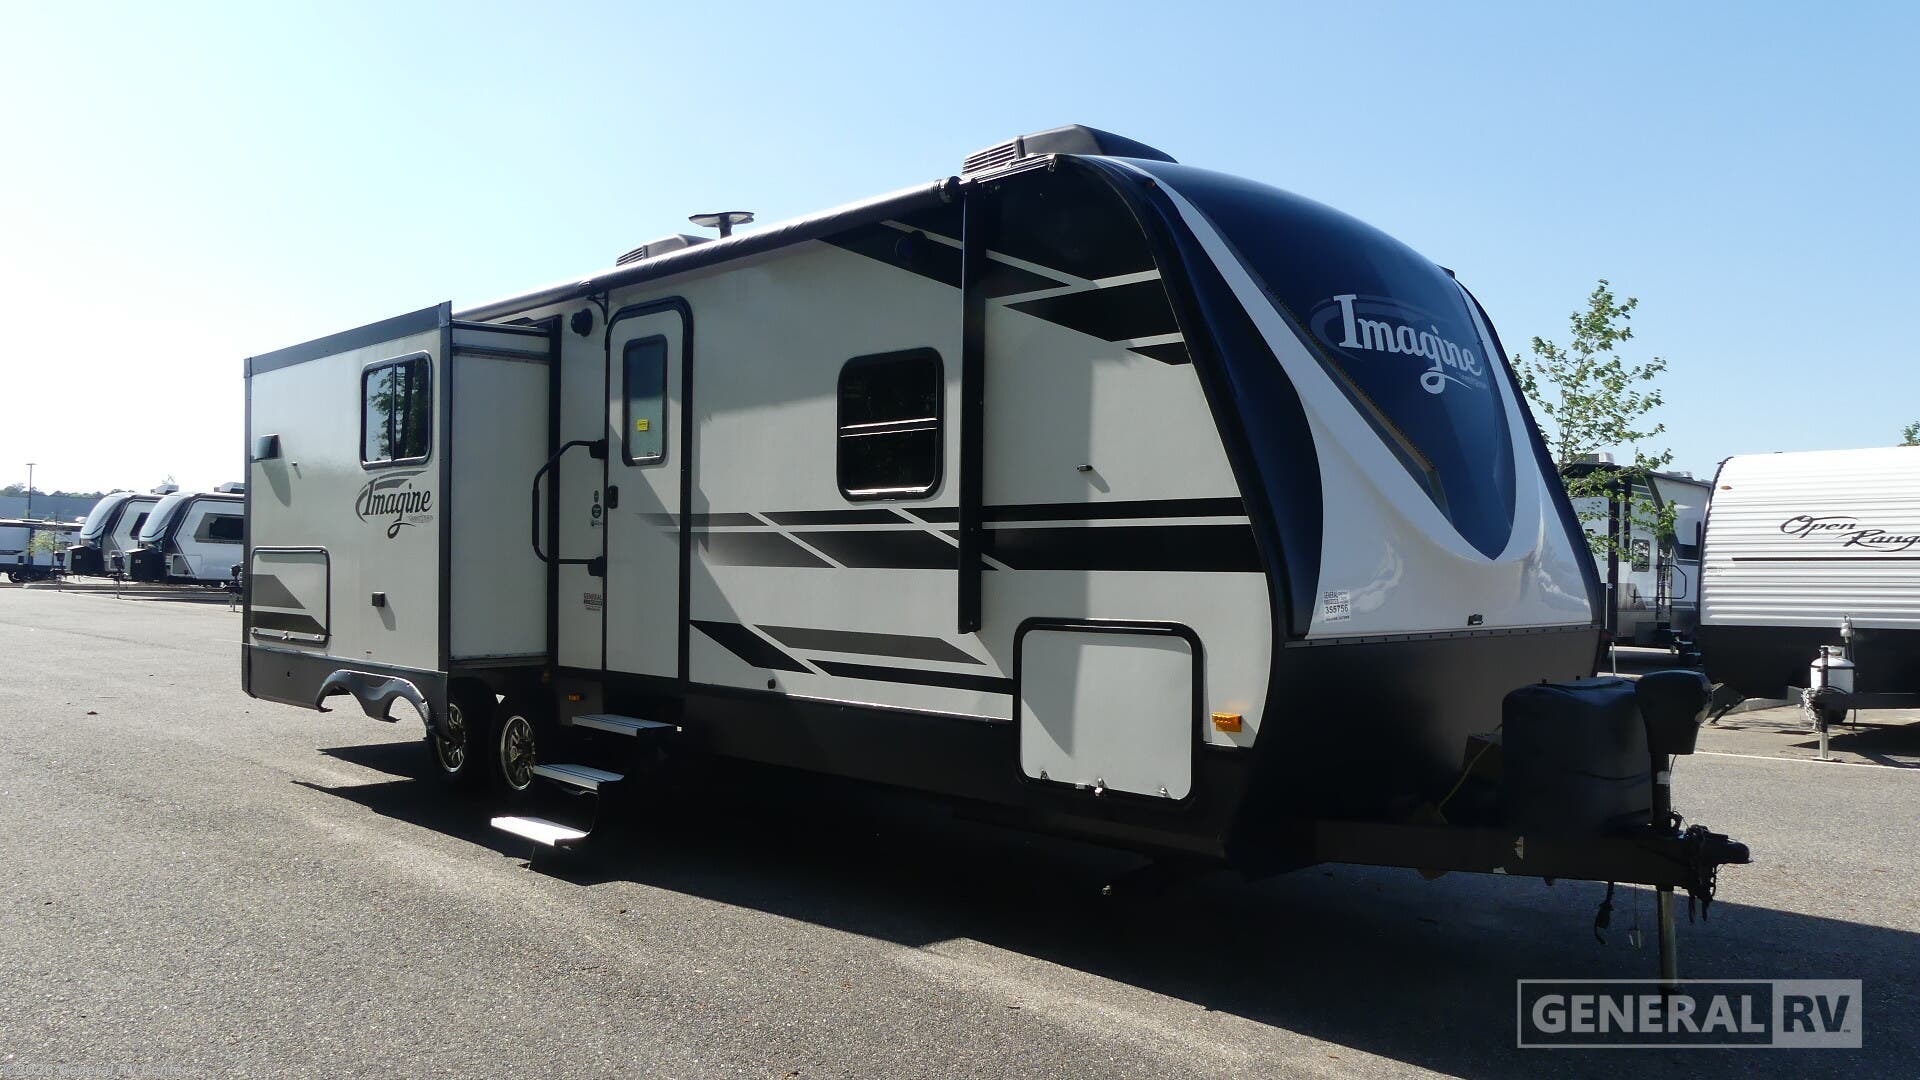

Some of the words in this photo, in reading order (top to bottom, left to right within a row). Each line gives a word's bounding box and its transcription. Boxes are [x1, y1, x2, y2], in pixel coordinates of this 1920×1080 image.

[1333, 294, 1482, 394] Imagine
[361, 477, 433, 539] Imagine
[1780, 515, 1858, 538] Open
